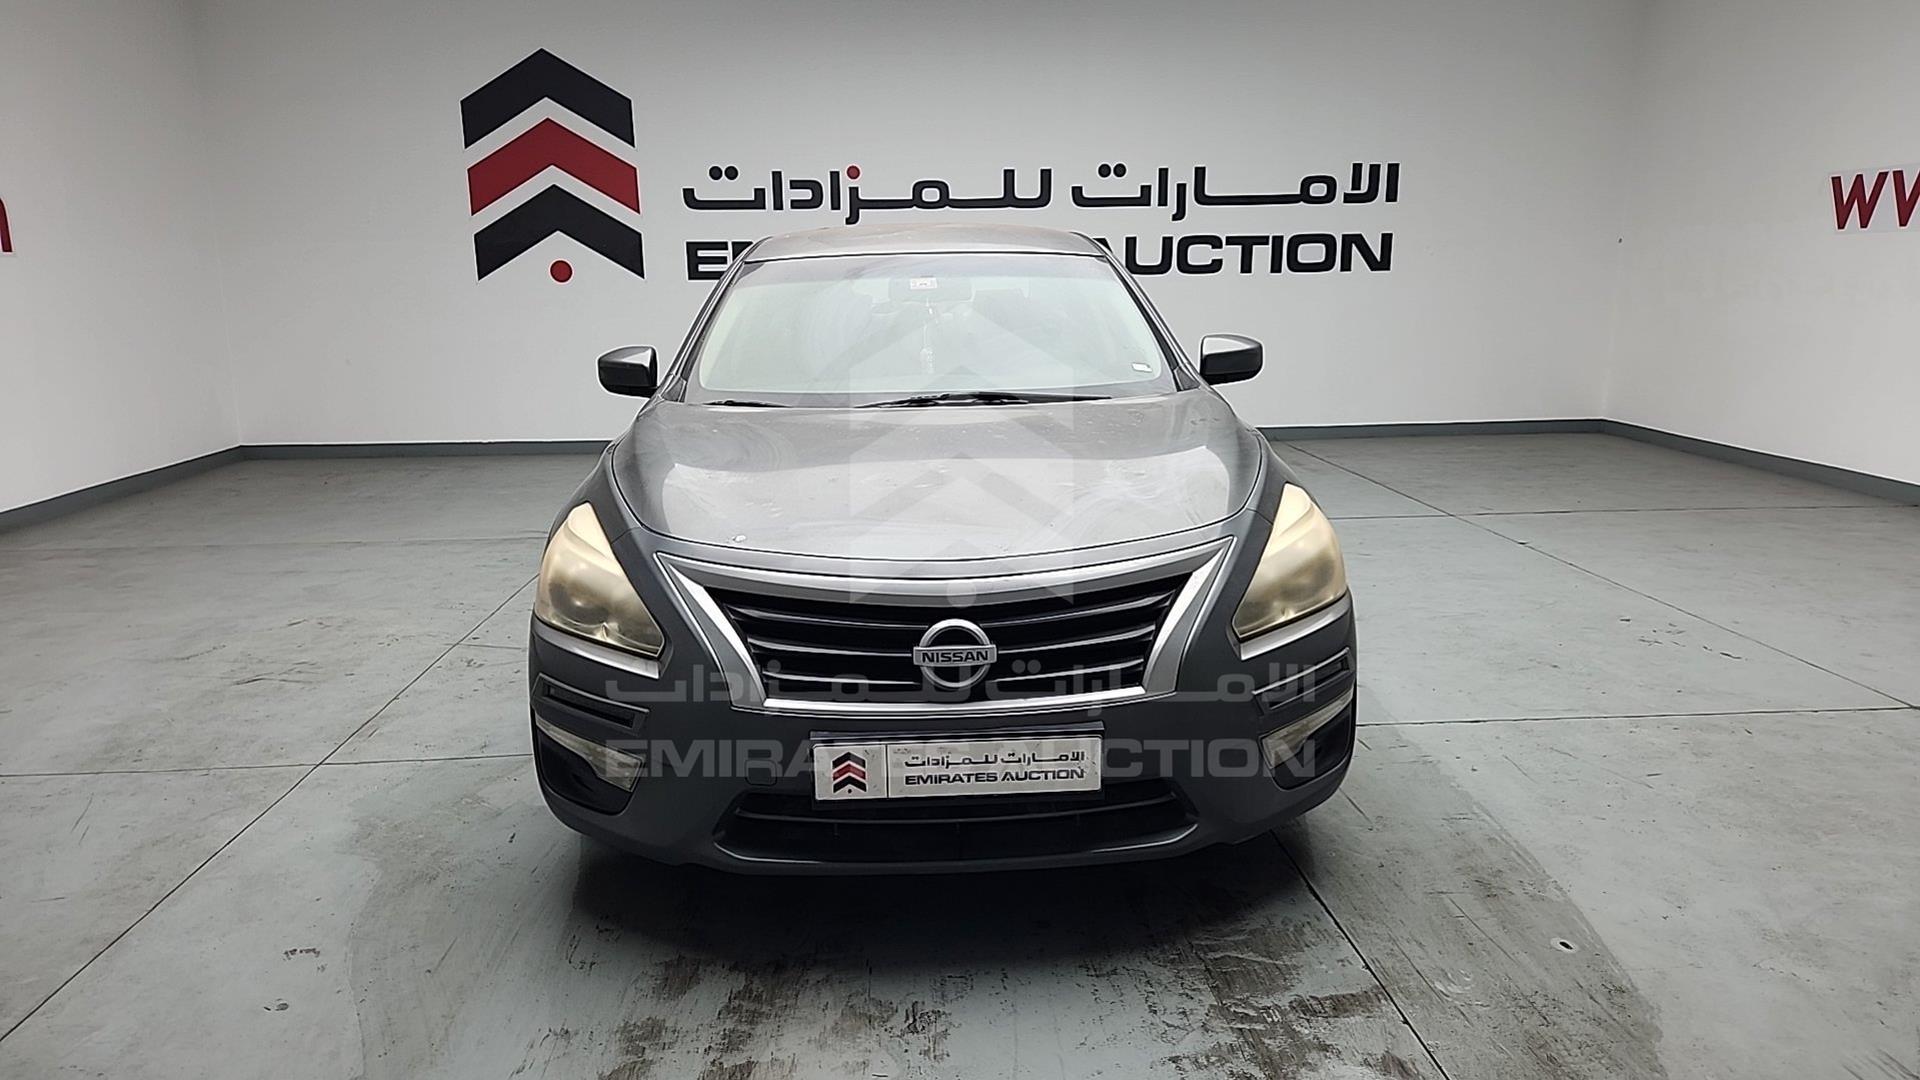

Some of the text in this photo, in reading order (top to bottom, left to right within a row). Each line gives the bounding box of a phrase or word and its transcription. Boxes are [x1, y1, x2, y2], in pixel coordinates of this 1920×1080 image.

[682, 162, 1400, 226] الامارات للمزادات
[1093, 232, 1394, 275] UCTION
[921, 650, 989, 663] NISSAN
[904, 751, 1085, 769] الامارات للمزادات
[905, 769, 1085, 785] EMIRATES AUCTION
